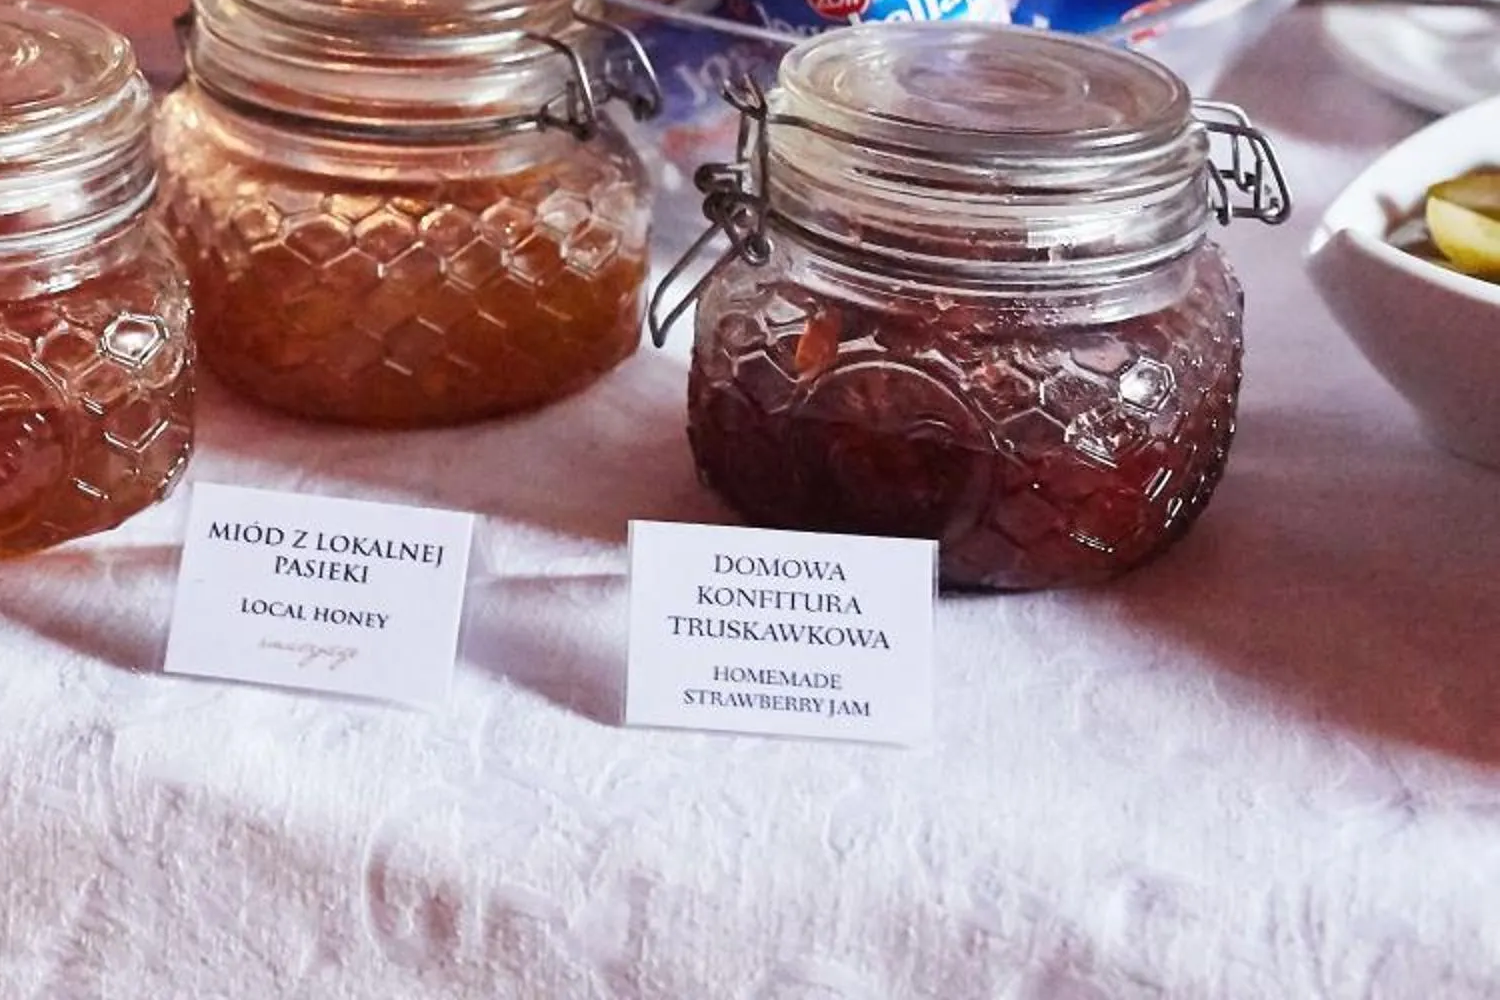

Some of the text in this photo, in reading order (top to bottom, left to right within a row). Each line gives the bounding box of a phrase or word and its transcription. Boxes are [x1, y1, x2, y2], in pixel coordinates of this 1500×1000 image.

[208, 521, 444, 568] MIÓD Z LOKALNEJ
[275, 555, 369, 584] PASIEKI
[714, 554, 847, 581] DOMOWA
[240, 597, 390, 630] LOCAL HONEY
[697, 585, 863, 615] KONFITURA
[667, 615, 890, 649] TRUSKAWKOWA
[713, 665, 842, 690] HOMEMADE
[683, 690, 871, 717] STRAWBERRY JAM
